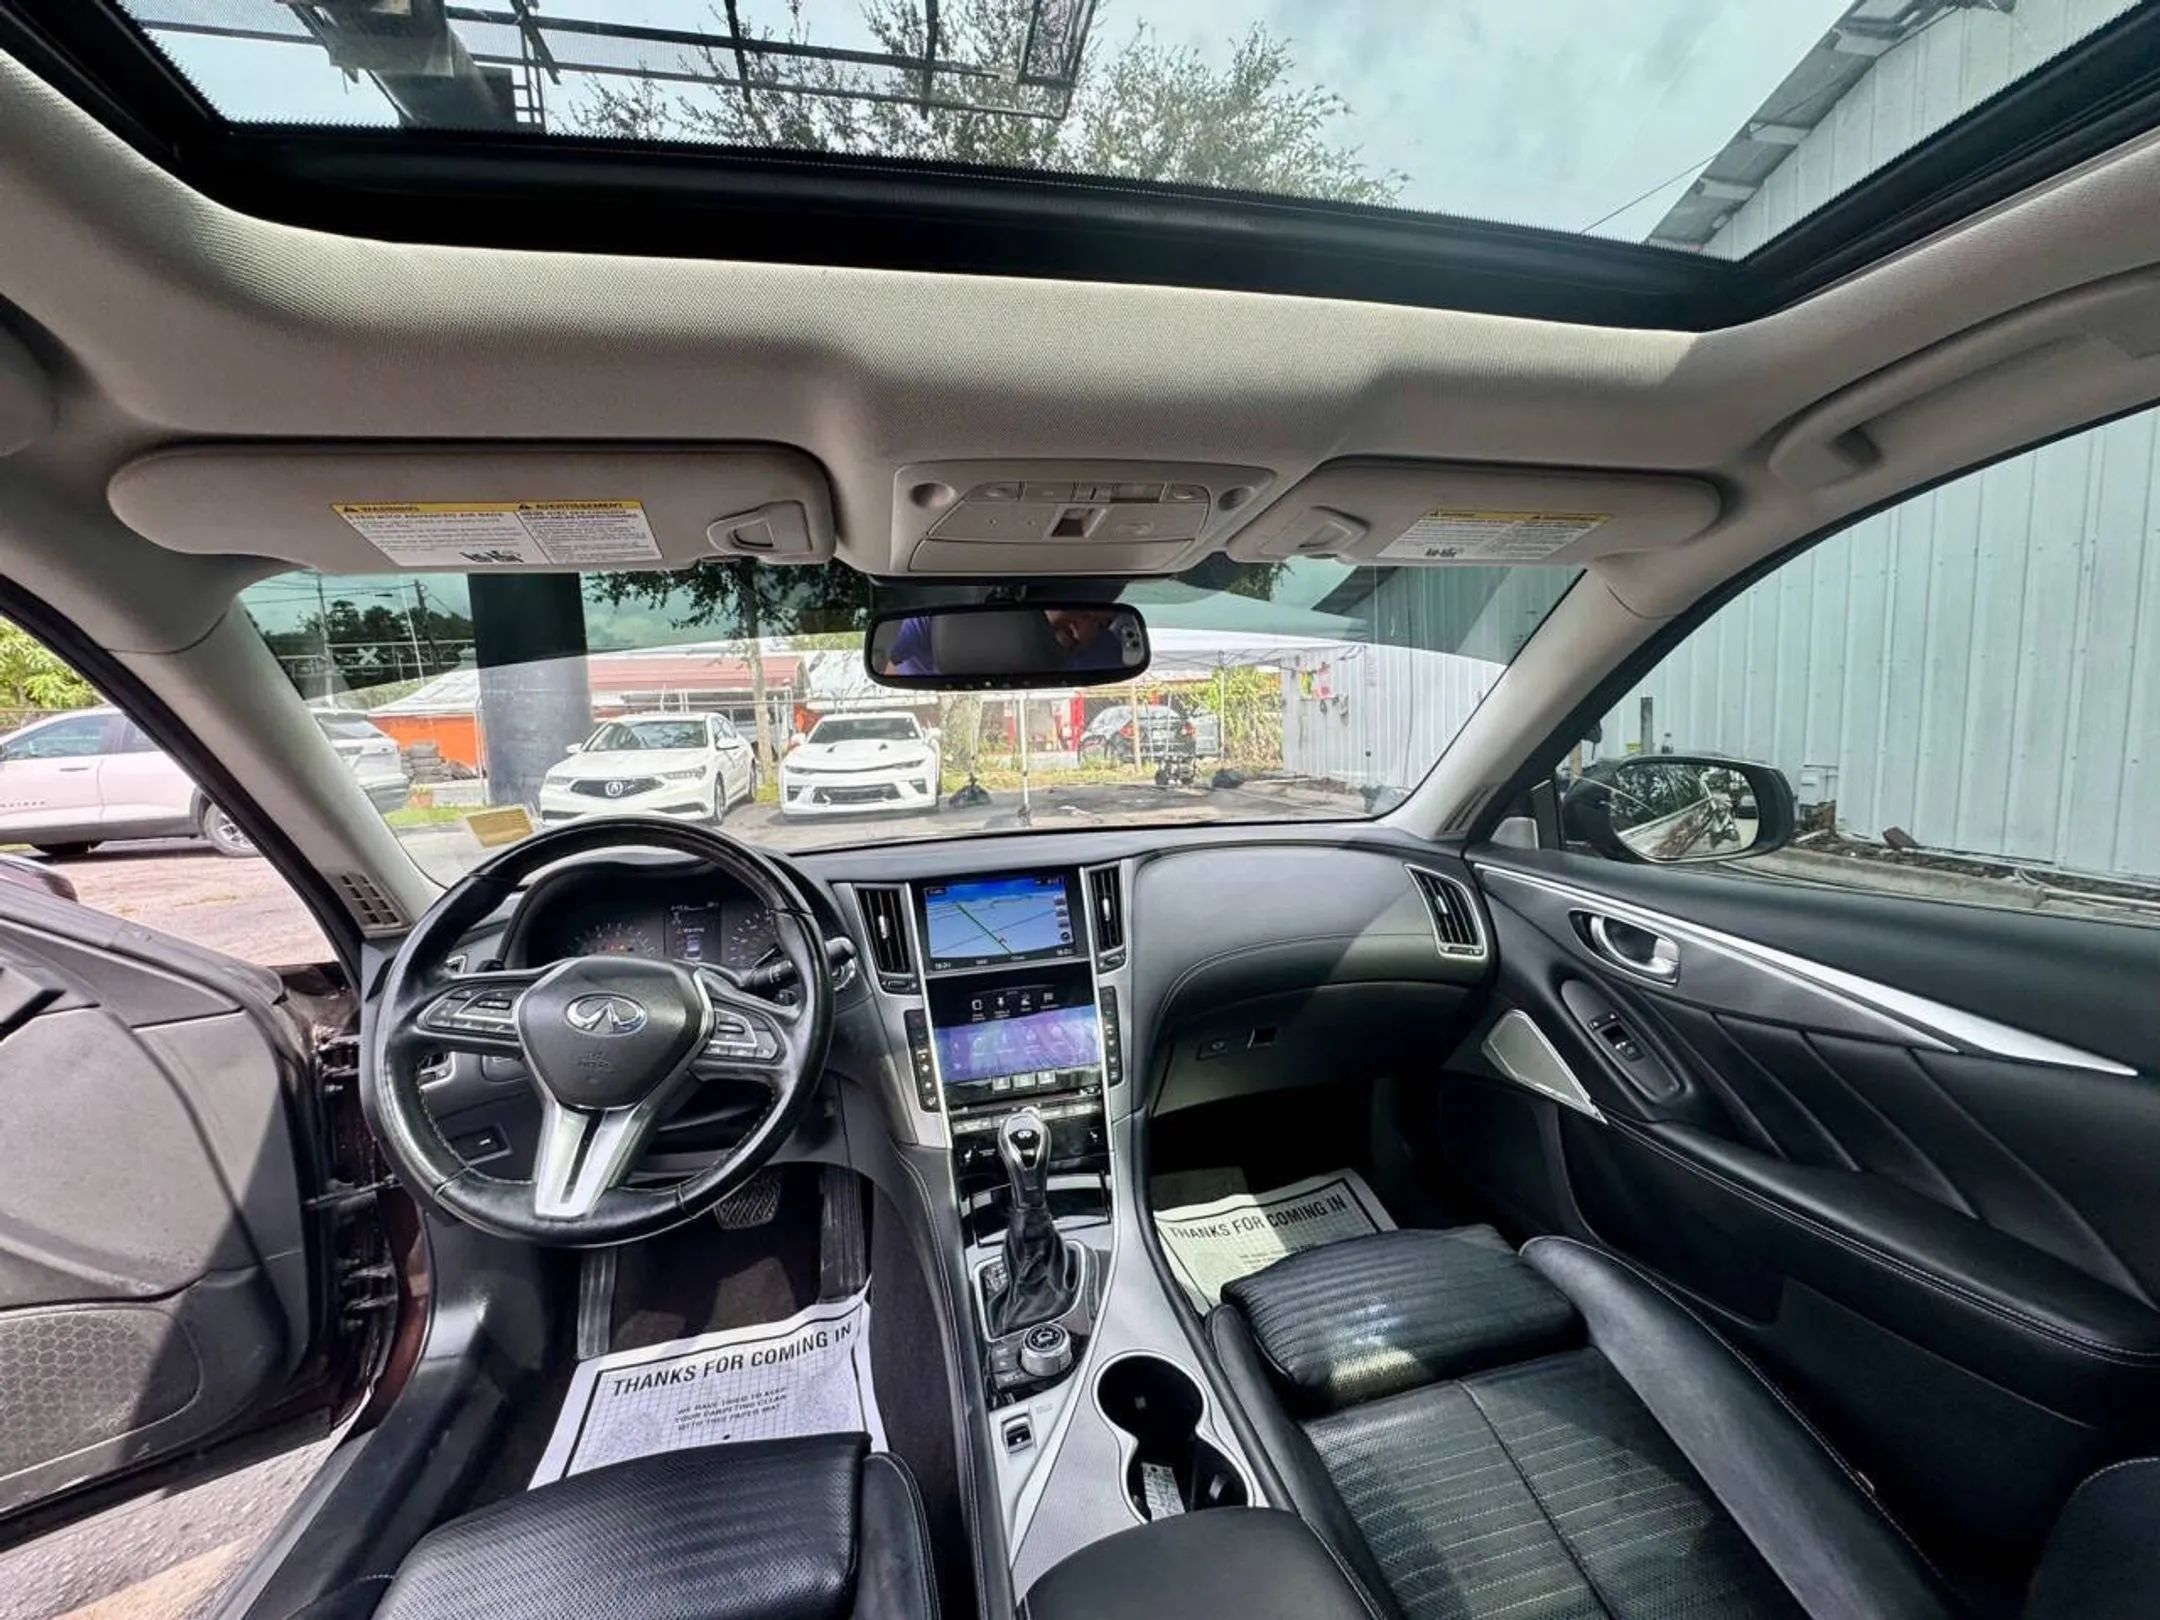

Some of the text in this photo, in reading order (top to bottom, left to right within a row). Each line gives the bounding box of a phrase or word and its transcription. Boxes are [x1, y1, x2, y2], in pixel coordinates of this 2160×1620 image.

[1168, 1194, 1348, 1240] THANKS FOR COMING IN
[613, 1323, 851, 1397] THANKS FOR COMING IN
